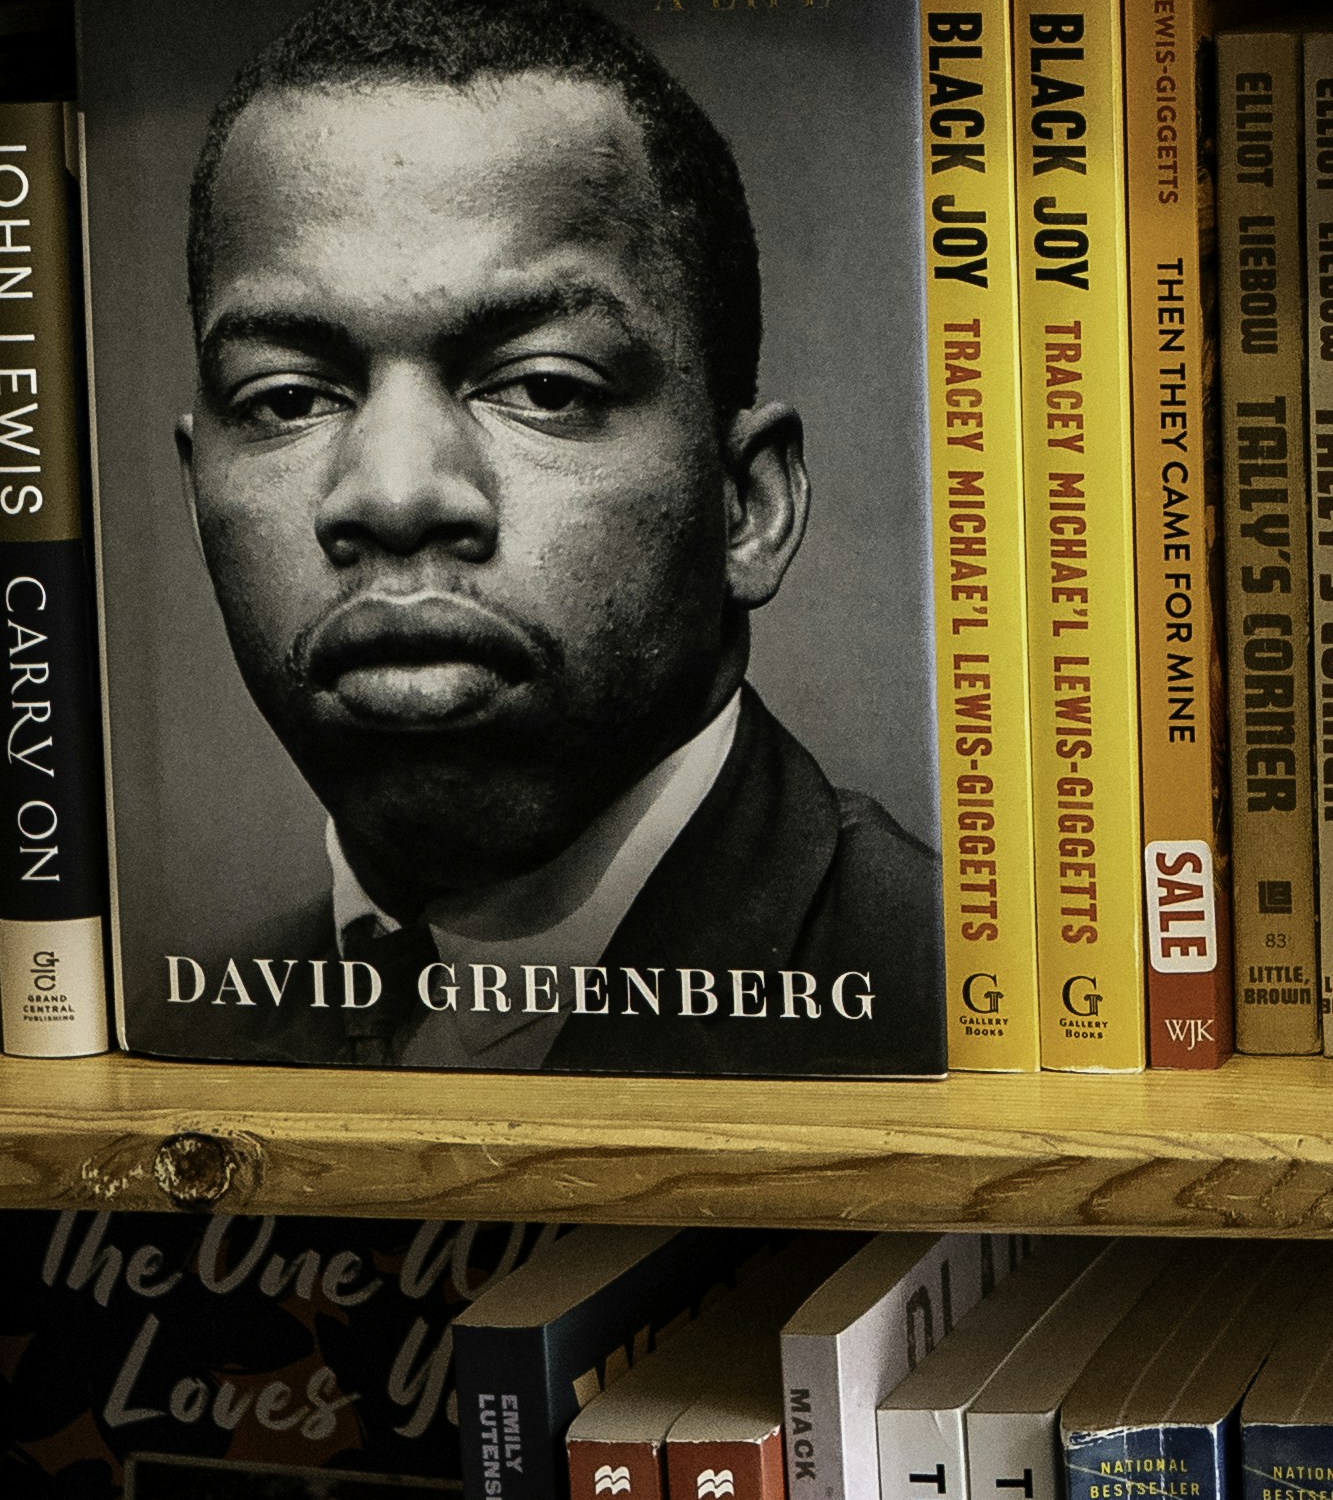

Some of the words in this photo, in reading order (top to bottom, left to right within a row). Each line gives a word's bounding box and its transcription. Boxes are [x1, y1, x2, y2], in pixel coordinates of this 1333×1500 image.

[928, 13, 984, 173] BLACK
[932, 195, 987, 288] JOY
[1156, 257, 1184, 352] THEN
[1159, 365, 1187, 453] THEY
[1161, 459, 1190, 562] CAME
[1164, 572, 1193, 644] FOR
[1166, 654, 1196, 744] MINE
[1155, 850, 1203, 959] SALE
[166, 956, 382, 1008] DAVID
[418, 963, 874, 1019] GREENBERG
